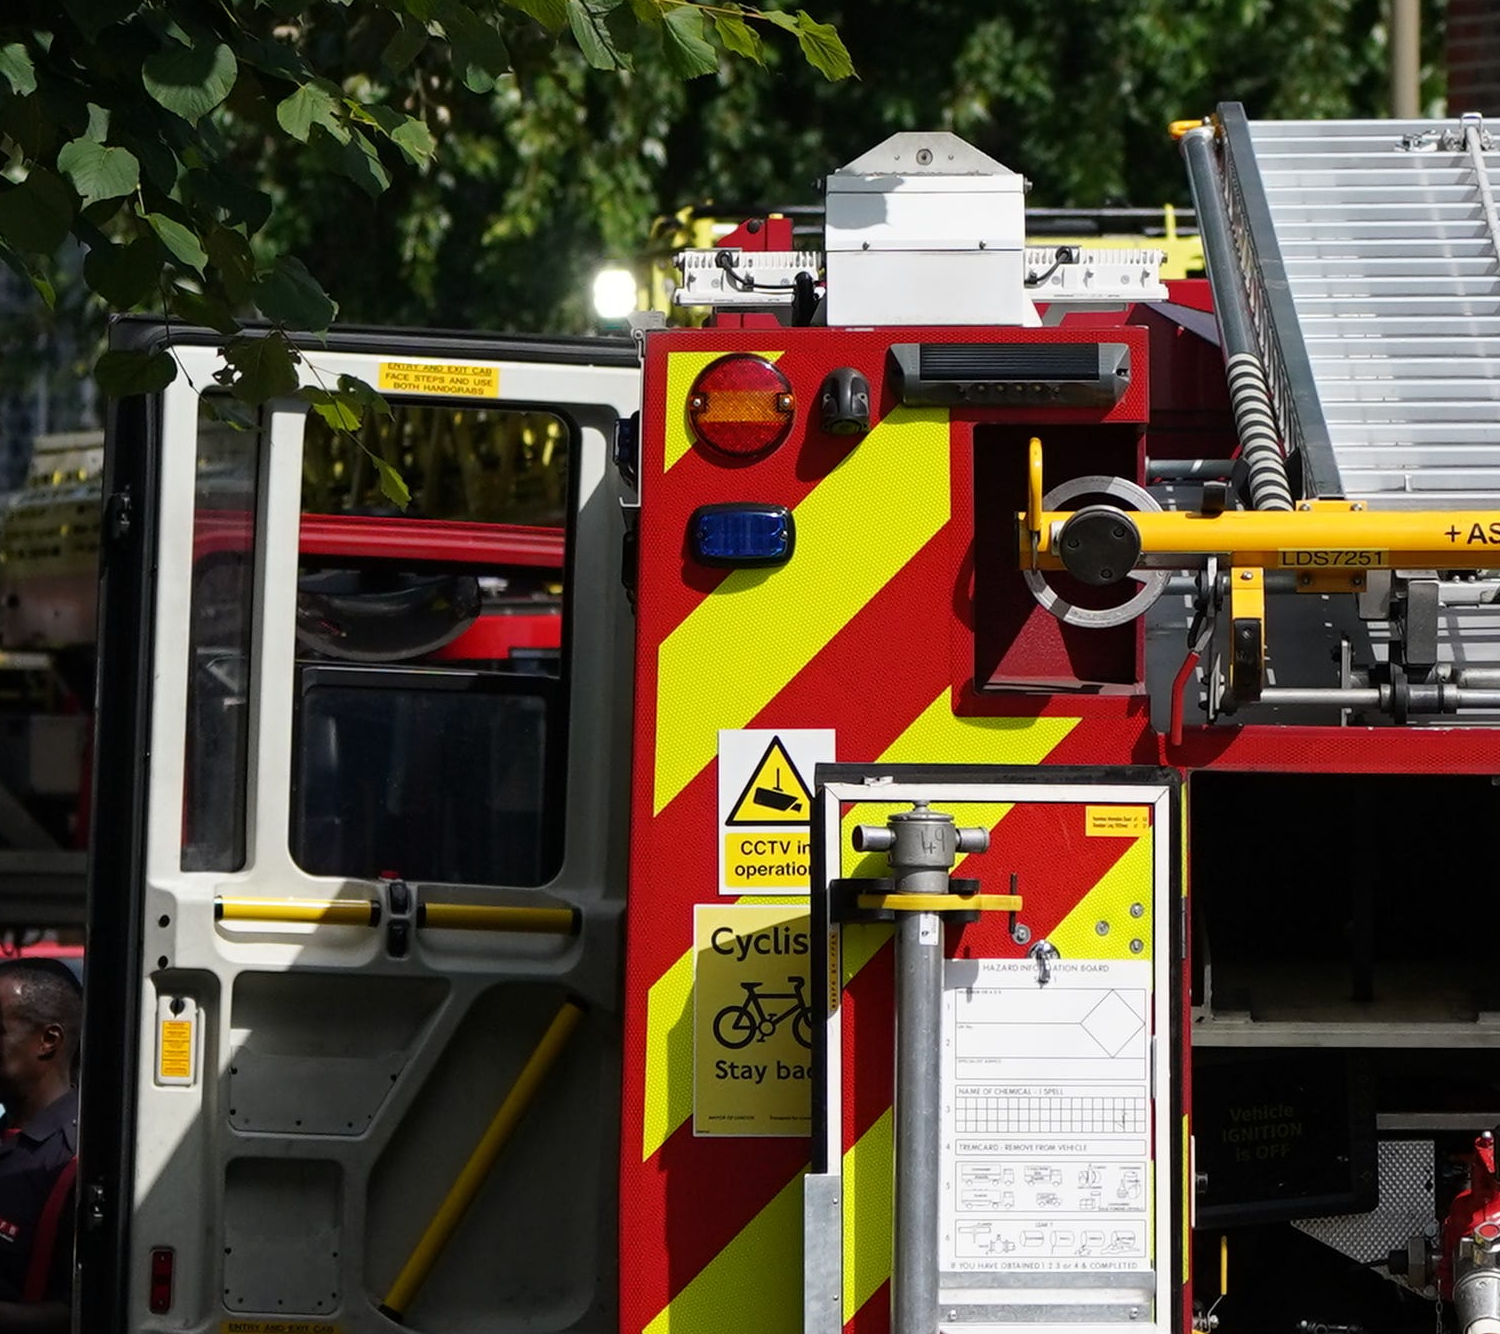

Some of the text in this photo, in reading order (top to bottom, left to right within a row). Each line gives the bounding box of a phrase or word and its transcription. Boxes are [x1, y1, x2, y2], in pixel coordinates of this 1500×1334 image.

[388, 363, 418, 371] ENTRY
[448, 366, 469, 374] EXIT
[385, 372, 492, 387] FACE STEPS AND USE
[394, 382, 484, 395] BOTH HANDGRABS
[1281, 550, 1385, 566] LDS7251
[740, 840, 791, 855] CCTV
[715, 1060, 767, 1084] Stay
[1229, 1104, 1294, 1121] Vehicle
[1222, 1123, 1302, 1142] IGNITION
[1256, 1143, 1290, 1159] OFF
[228, 1323, 259, 1332] ENTRY
[265, 1324, 285, 1332] AND
[313, 1325, 334, 1333] CAB
